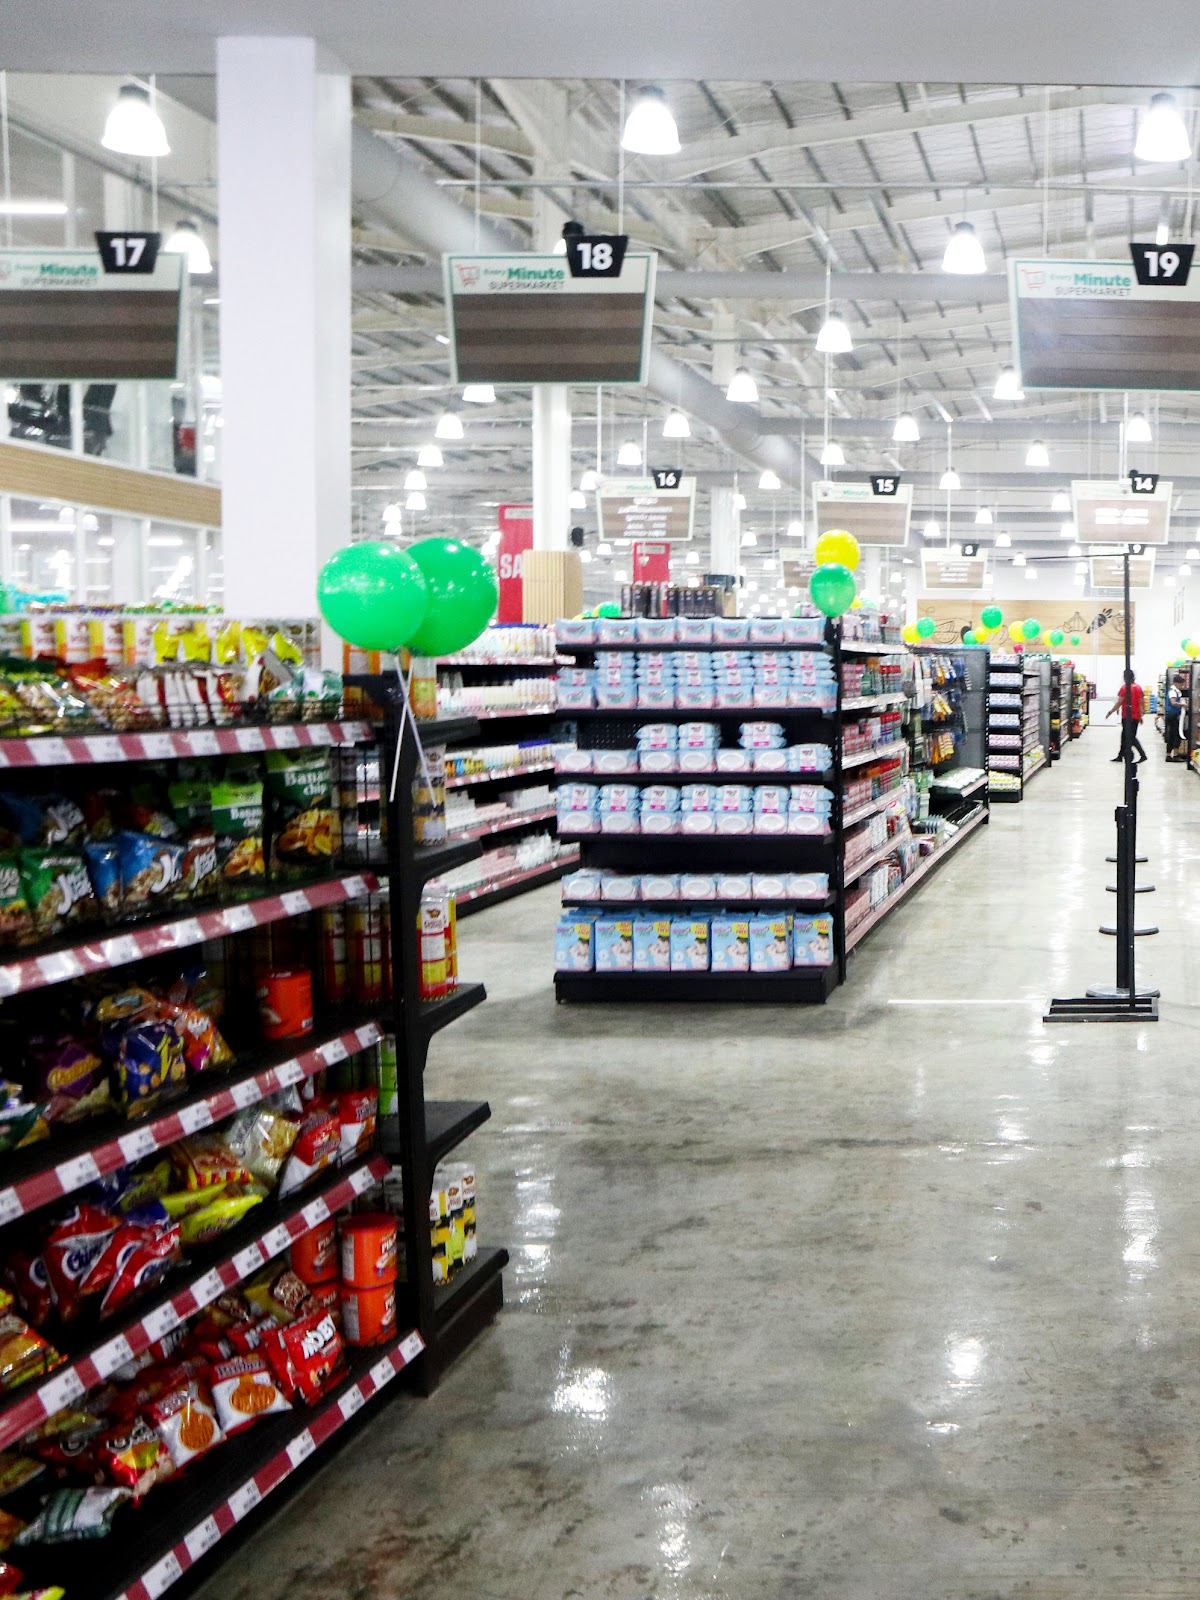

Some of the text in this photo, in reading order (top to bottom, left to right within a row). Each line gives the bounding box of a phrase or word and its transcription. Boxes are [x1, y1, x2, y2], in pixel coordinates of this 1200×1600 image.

[110, 238, 146, 267] 17
[577, 243, 613, 271] 18
[40, 263, 98, 277] Minute
[1144, 251, 1180, 278] 19
[508, 267, 565, 280] Minute
[1074, 273, 1131, 287] Minute
[488, 280, 565, 291] SUPERMARKET
[1055, 286, 1132, 297] SUPERMARKET
[657, 472, 677, 487] 16
[876, 479, 895, 492] 15
[1134, 477, 1154, 490] 14
